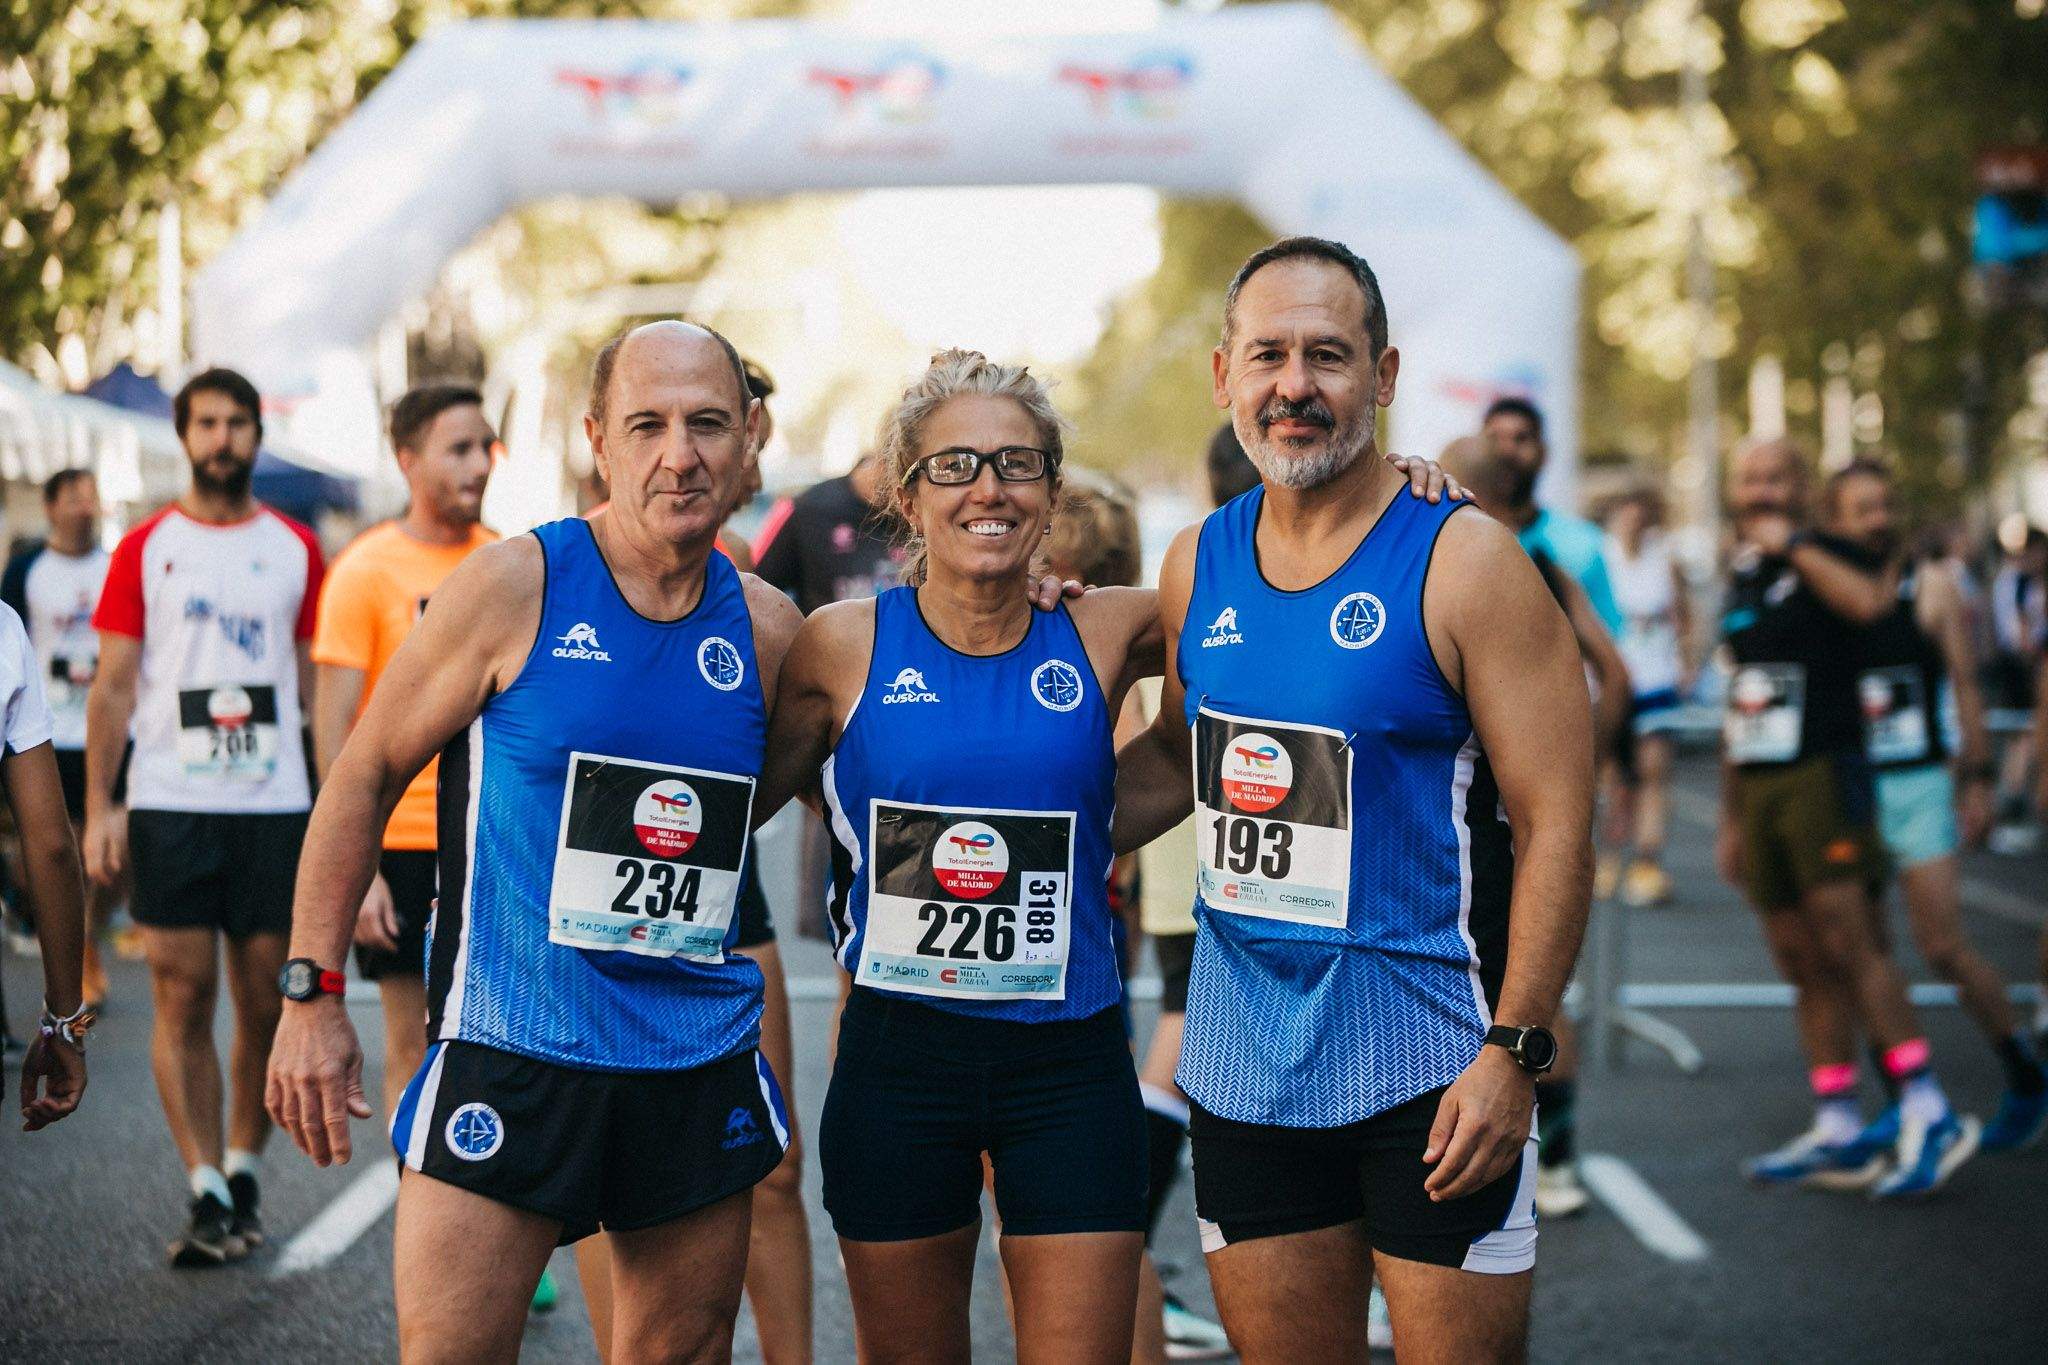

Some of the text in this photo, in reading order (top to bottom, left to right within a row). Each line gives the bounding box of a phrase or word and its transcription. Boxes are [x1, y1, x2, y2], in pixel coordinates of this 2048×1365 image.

[1202, 633, 1244, 648] austral
[552, 647, 612, 661] austral
[883, 693, 940, 704] austral
[1233, 769, 1277, 780] TotalEnergies
[1241, 785, 1266, 794] MILLA
[1244, 793, 1276, 803] MADRID
[649, 815, 690, 826] TotalEnergies
[657, 830, 681, 840] MILLA
[646, 837, 688, 848] DE MADRID
[1213, 816, 1293, 880] 193
[948, 858, 993, 866] TotalEnergies
[958, 872, 983, 880] MILLA
[611, 859, 702, 922] 234
[960, 881, 993, 889] MADRID
[1026, 880, 1057, 944] 3188
[576, 921, 621, 935] MADRID
[917, 902, 1016, 962] 226
[886, 965, 929, 978] MADRID
[960, 970, 986, 978] MILLA
